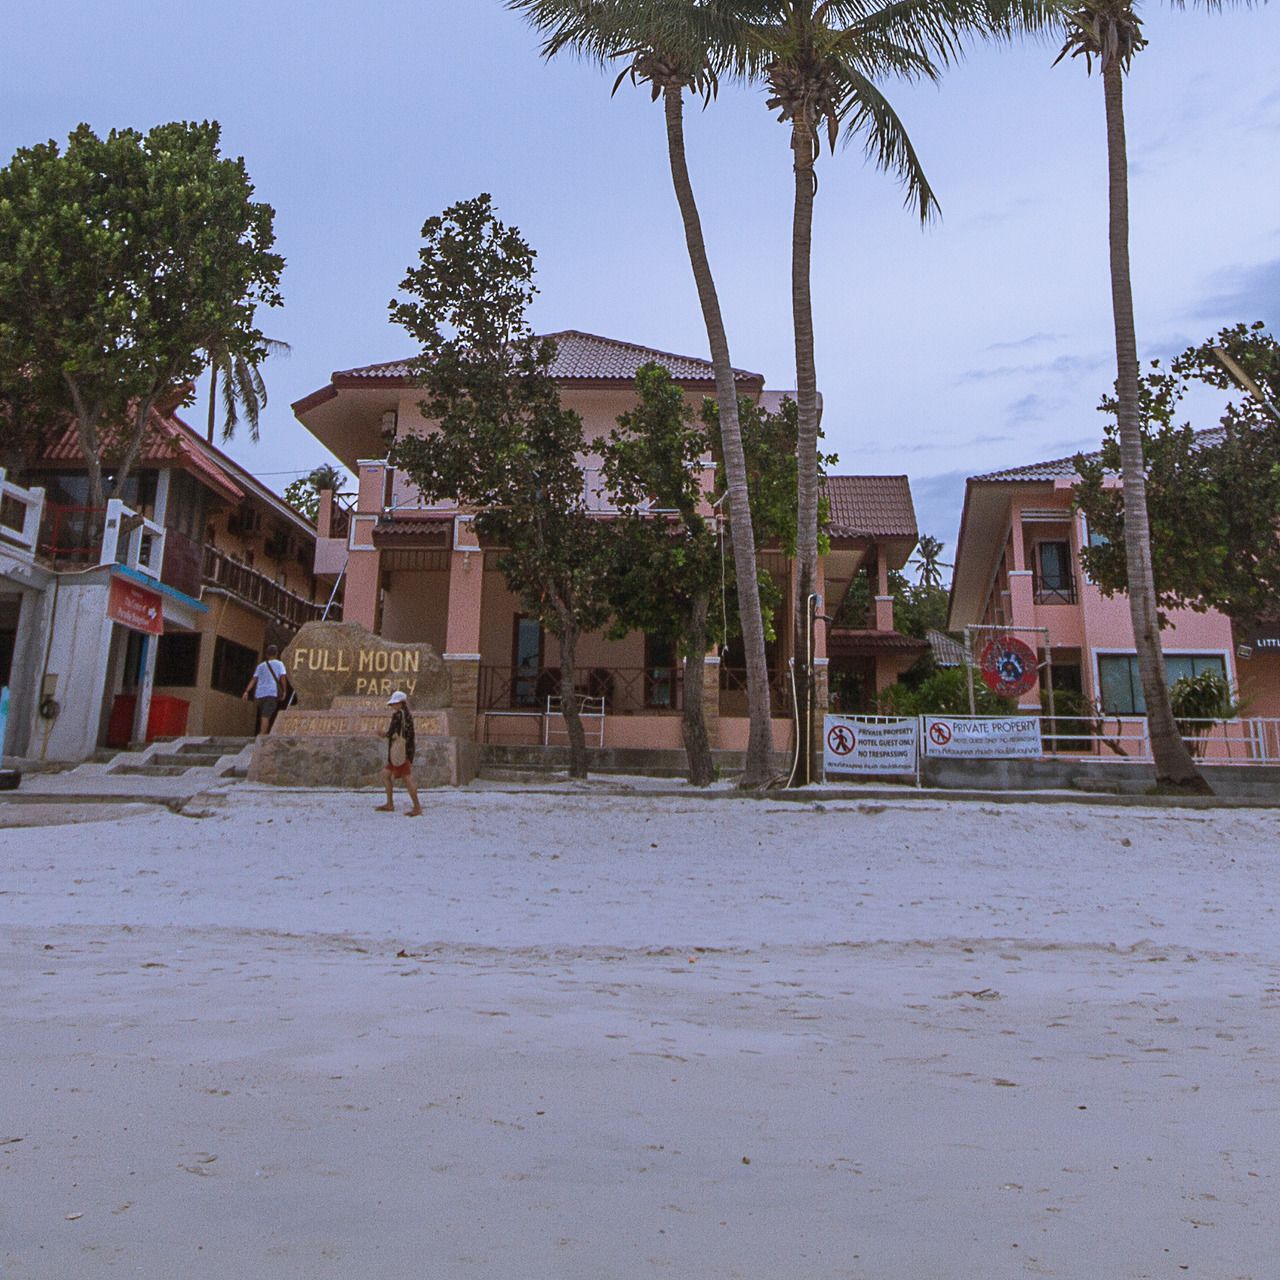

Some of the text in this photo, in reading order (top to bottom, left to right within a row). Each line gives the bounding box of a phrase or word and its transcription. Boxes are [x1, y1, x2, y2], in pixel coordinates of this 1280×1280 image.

[293, 648, 420, 672] FULL MOON
[356, 678, 417, 695] PARTY
[858, 728, 913, 736] PRIVATE PROPERTY
[952, 720, 1037, 733] PRIVATE PROPERTY
